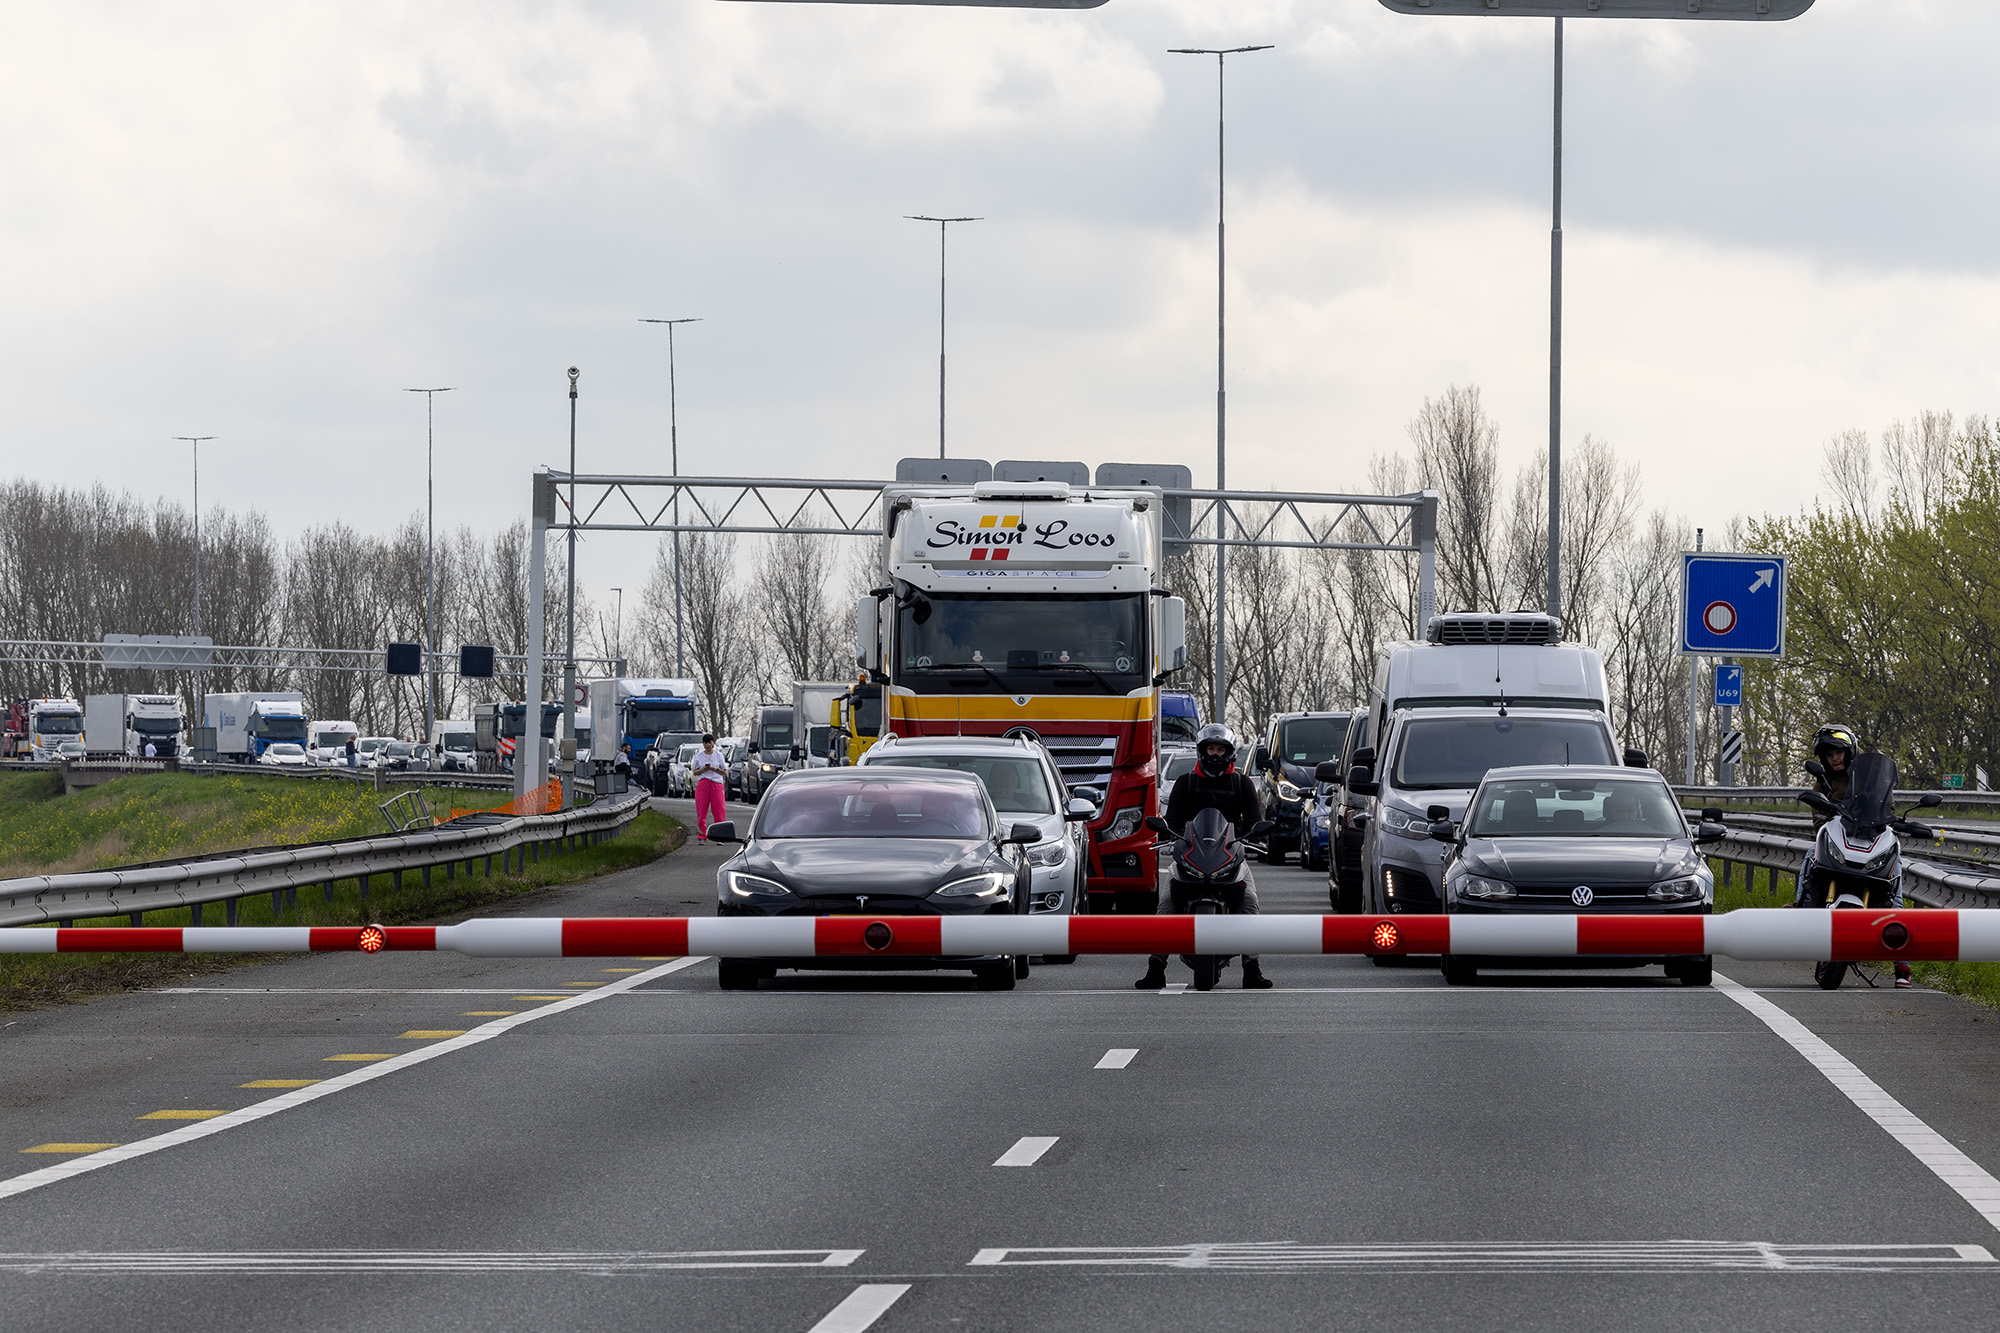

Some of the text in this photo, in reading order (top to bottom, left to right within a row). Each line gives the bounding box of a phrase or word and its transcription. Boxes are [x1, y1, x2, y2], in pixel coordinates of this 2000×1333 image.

[926, 520, 1115, 549] Simon Loos
[1718, 689, 1739, 697] U69
